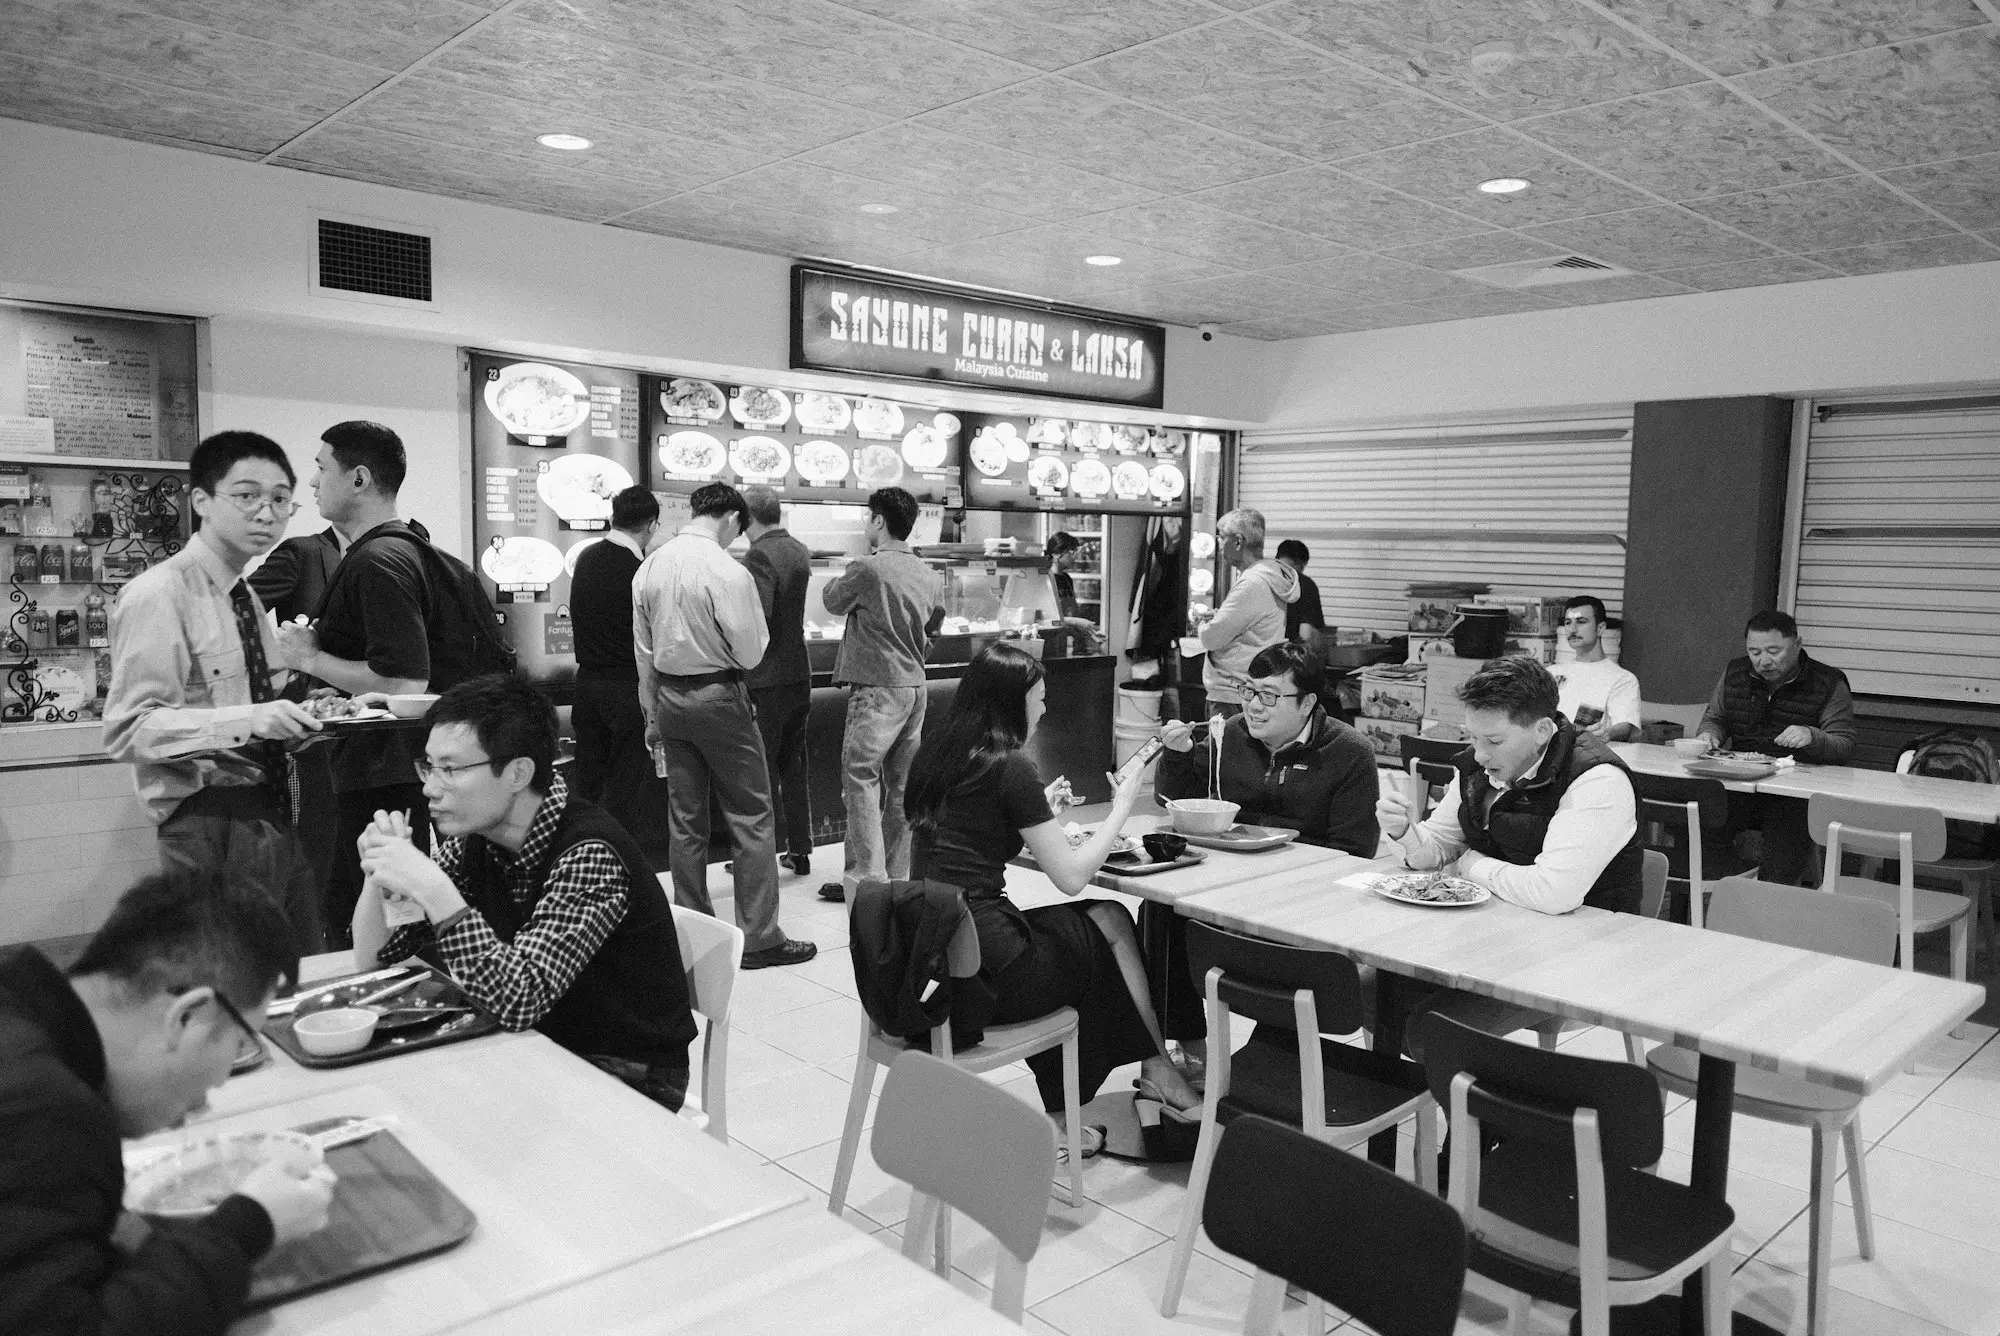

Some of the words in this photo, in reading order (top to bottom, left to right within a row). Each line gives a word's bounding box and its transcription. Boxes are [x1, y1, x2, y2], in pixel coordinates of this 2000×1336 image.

[830, 291, 948, 354] SAYONG
[962, 312, 1045, 367] CURRY
[1049, 338, 1064, 361] &
[1071, 329, 1144, 380] LAKSA
[488, 368, 498, 380] 22
[955, 357, 1004, 378] Malaysia
[1006, 364, 1049, 382] Cuisine
